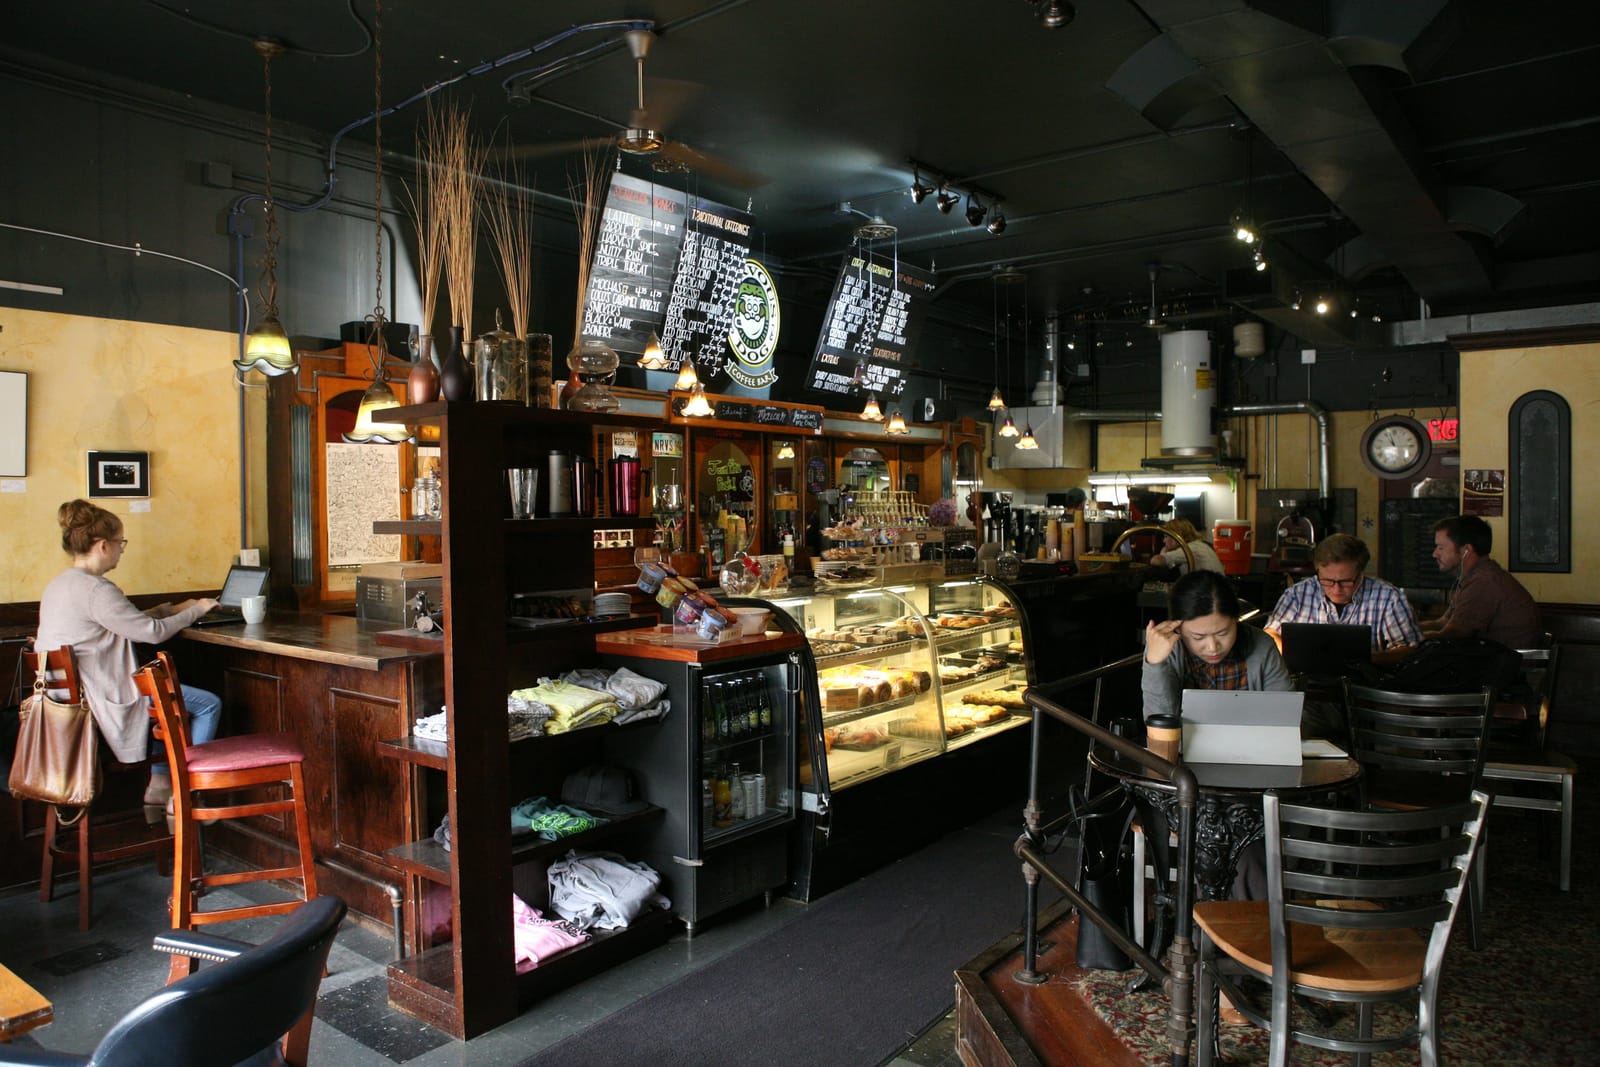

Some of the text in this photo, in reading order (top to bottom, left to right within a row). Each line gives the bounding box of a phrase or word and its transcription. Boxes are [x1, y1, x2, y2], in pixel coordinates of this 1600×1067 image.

[601, 232, 635, 249] HARVEST
[701, 235, 719, 250] LATTE
[598, 244, 622, 261] NUTTY
[597, 256, 648, 276] TRIPLE THREAT
[592, 277, 622, 294] MOCHAS
[585, 311, 608, 326] BLACK
[735, 341, 770, 362] DOG
[731, 367, 756, 387] COFFEE
[757, 374, 772, 386] BAR
